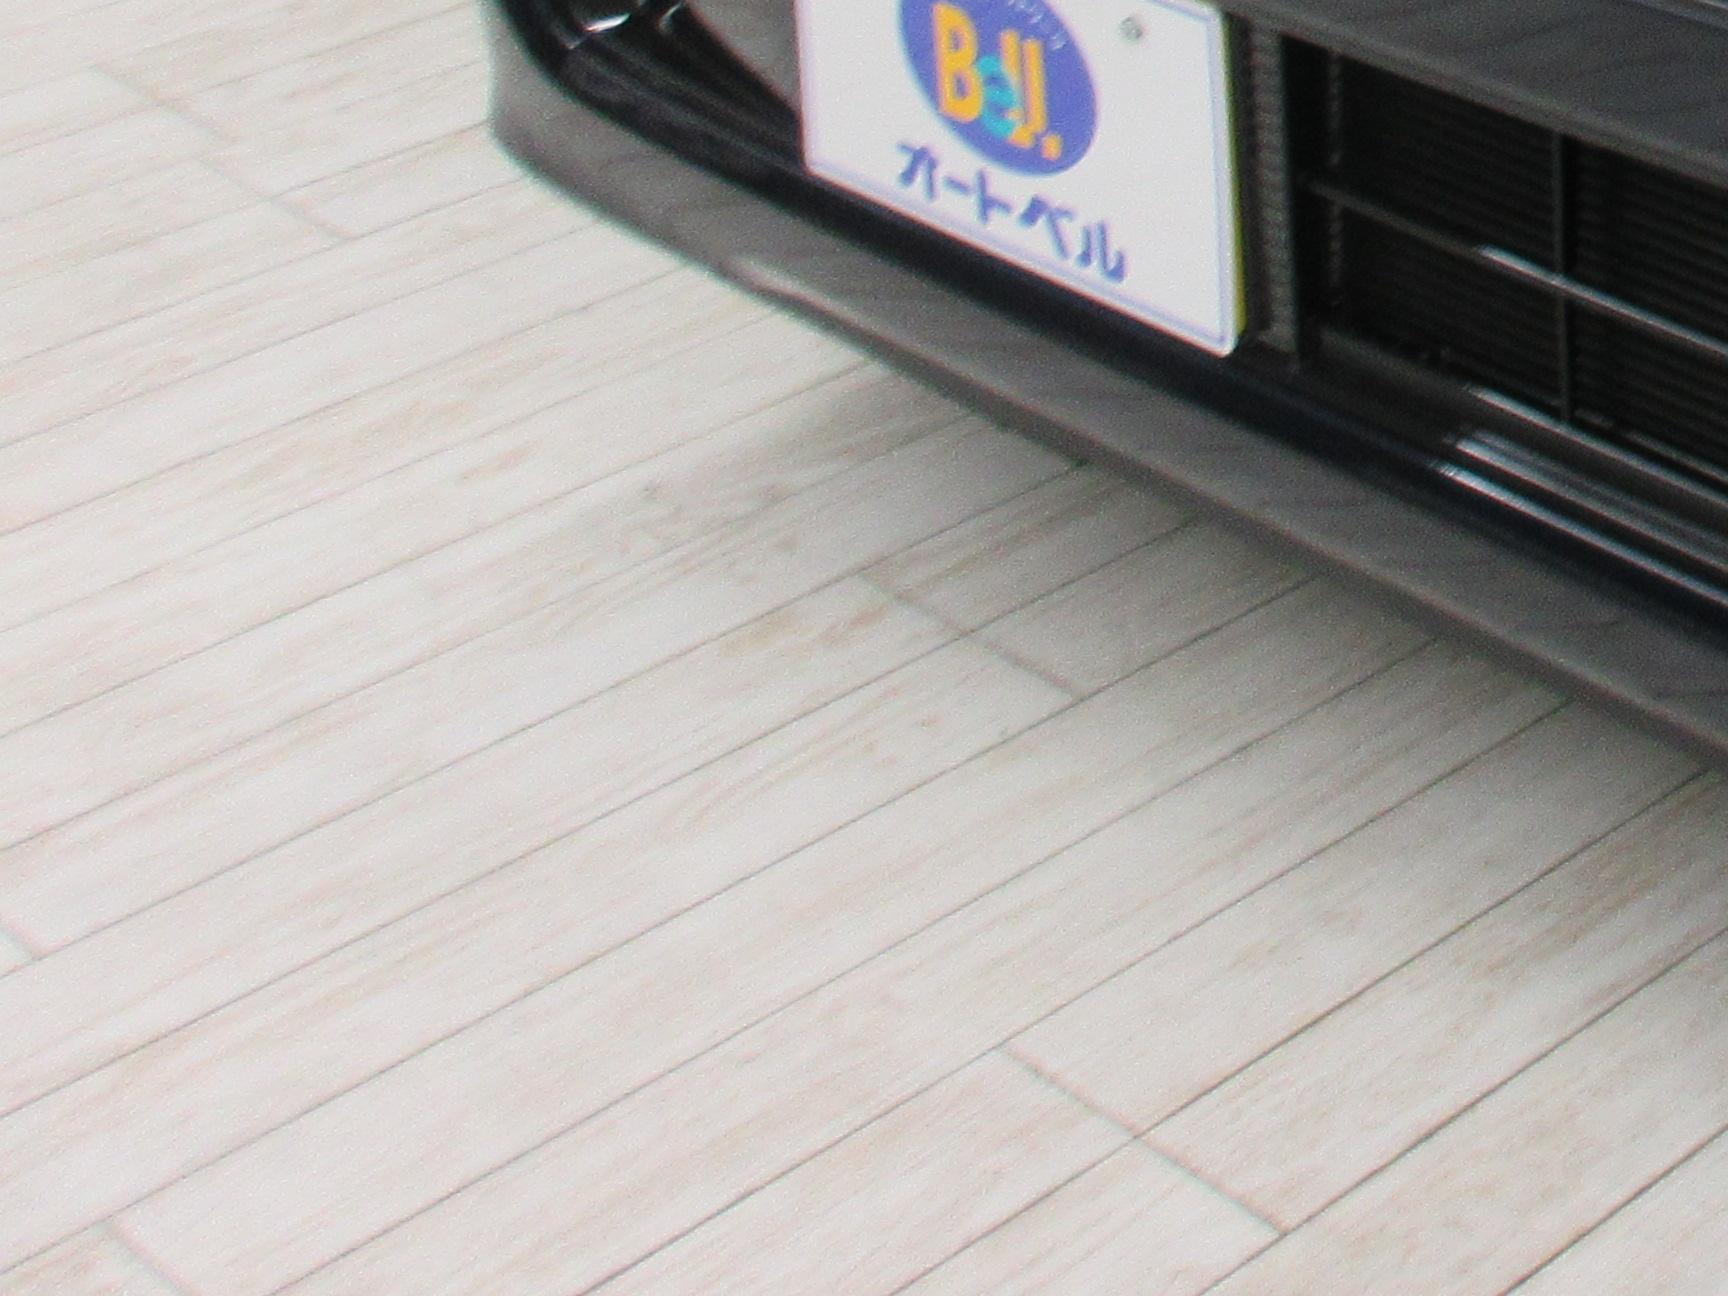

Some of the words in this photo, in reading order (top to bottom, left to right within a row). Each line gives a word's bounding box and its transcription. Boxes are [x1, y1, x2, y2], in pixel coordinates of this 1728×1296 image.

[897, 141, 1127, 283] オートベル
